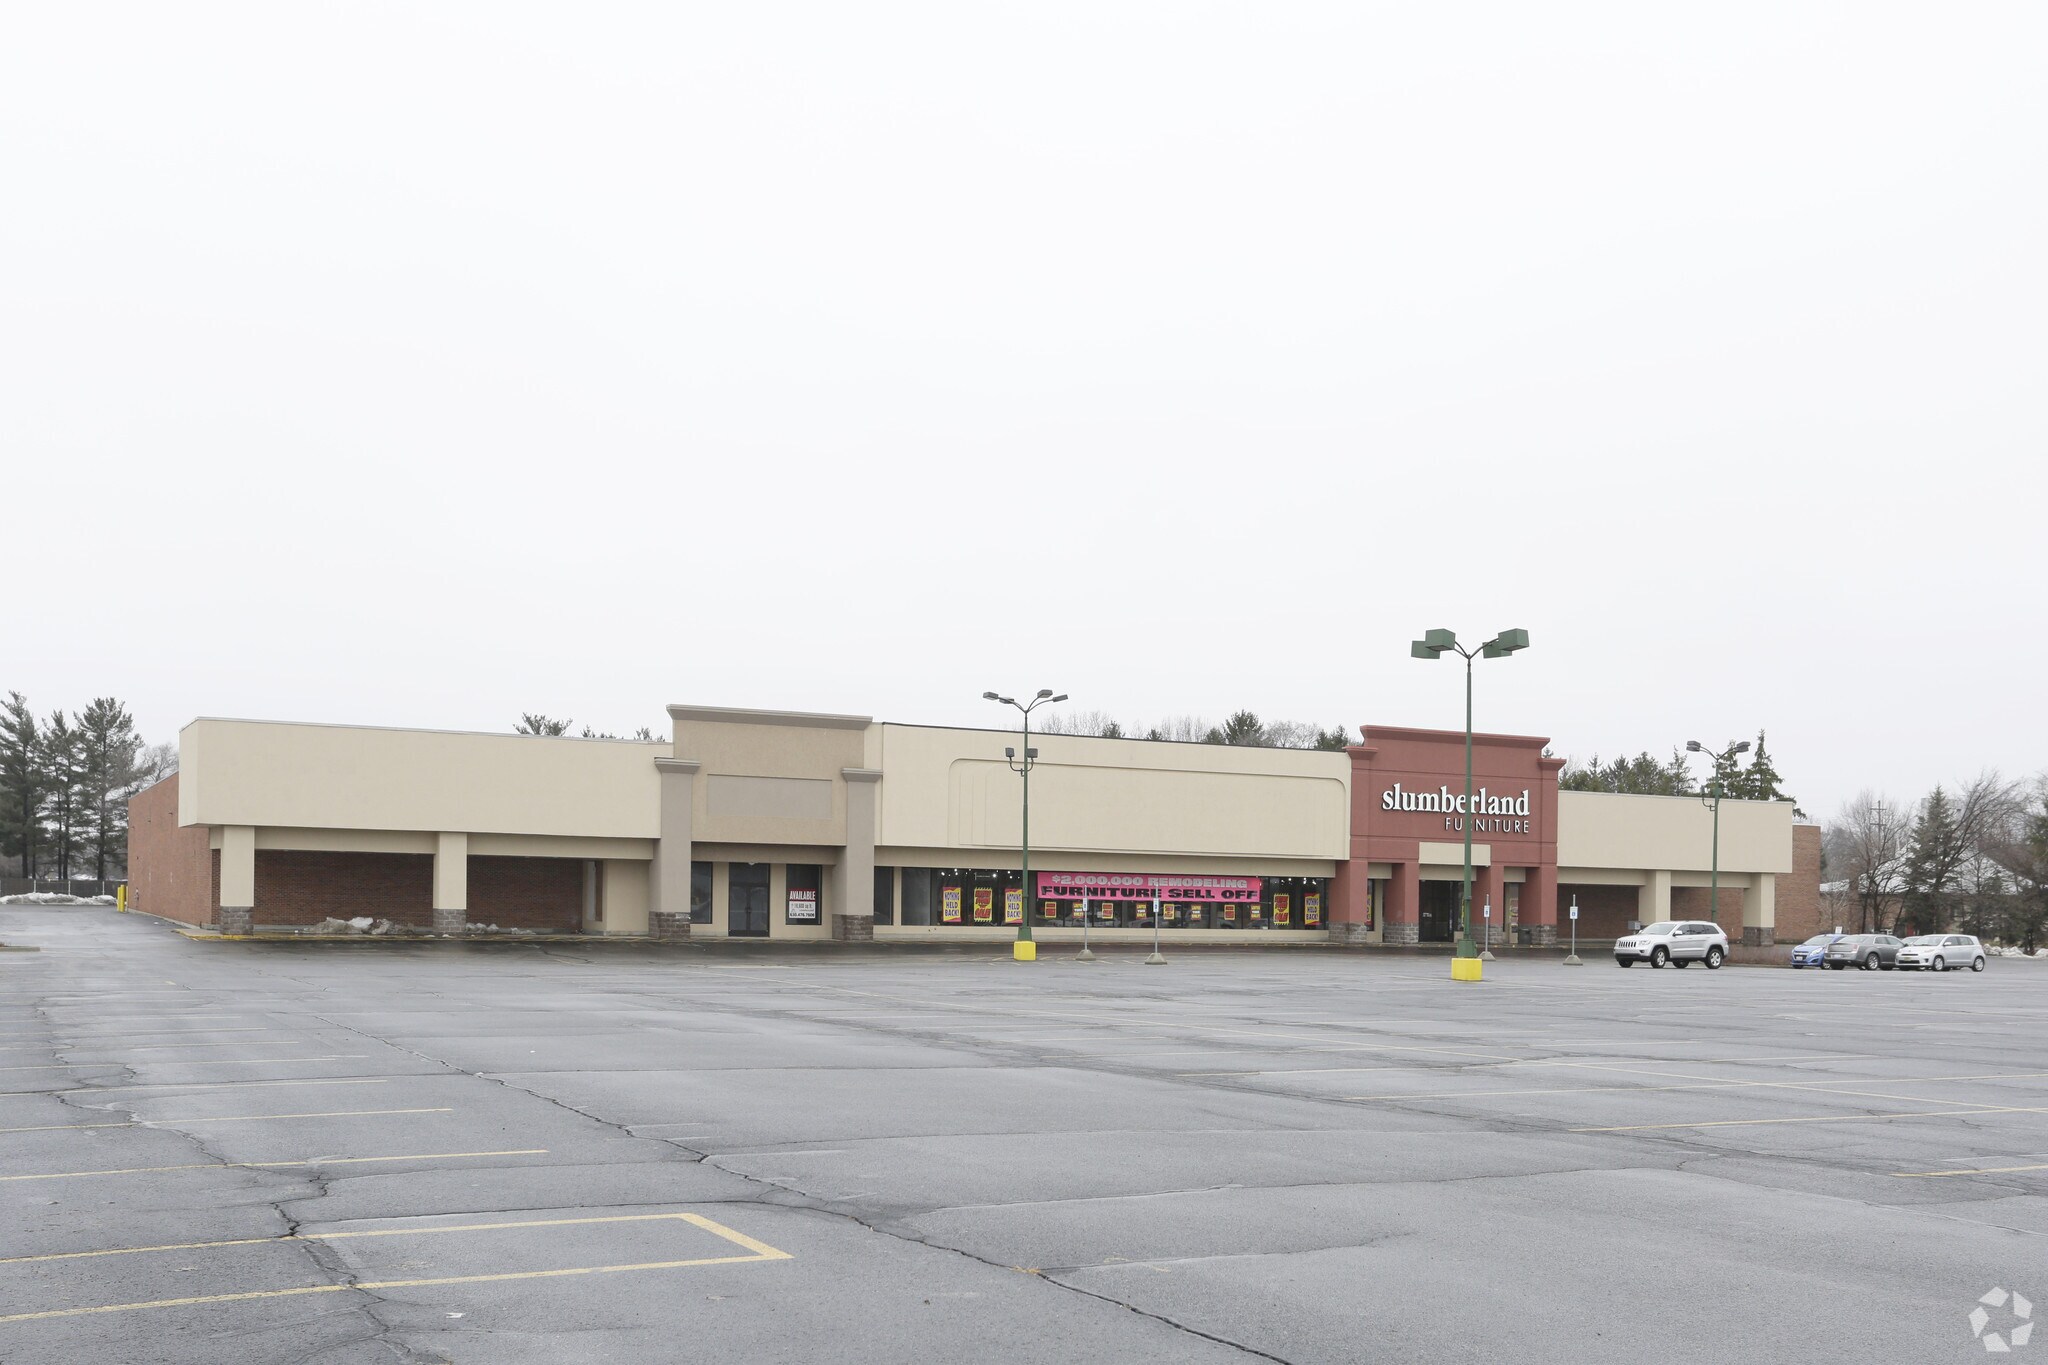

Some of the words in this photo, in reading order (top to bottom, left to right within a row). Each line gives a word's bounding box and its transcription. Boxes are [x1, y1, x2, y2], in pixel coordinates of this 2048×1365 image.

[1381, 782, 1530, 817] slumberland
[1444, 817, 1529, 834] FUNITURE
[1051, 874, 1144, 886] $2,000,000
[1148, 877, 1248, 888] REMODELING
[789, 890, 816, 901] AVAILABLE
[1041, 886, 1162, 898] FURNITURE
[1168, 888, 1215, 899] SELL
[1221, 889, 1258, 900] OFF
[945, 901, 958, 909] HELD
[1007, 902, 1020, 910] HELD
